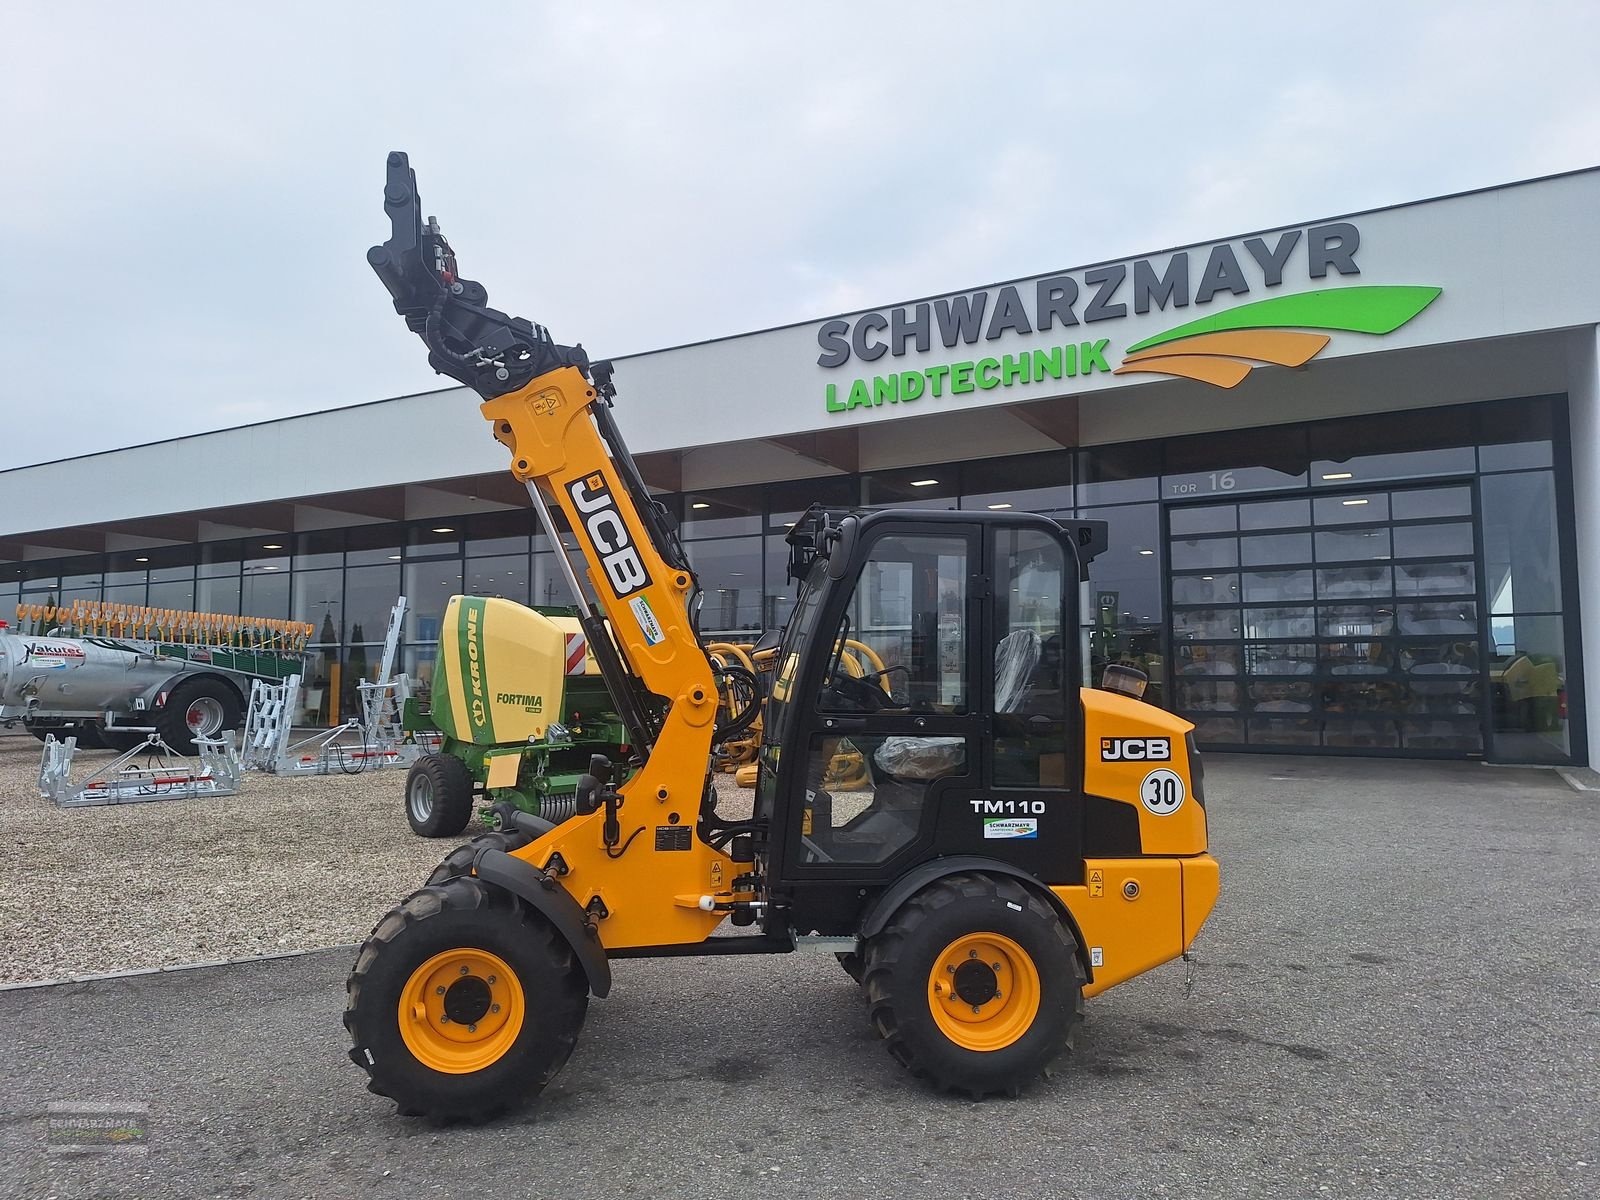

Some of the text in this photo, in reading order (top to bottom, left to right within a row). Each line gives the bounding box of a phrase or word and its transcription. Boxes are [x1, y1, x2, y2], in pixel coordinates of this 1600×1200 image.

[816, 222, 1361, 368] SCHWARZMAYR
[826, 338, 1110, 413] LANDTECHNIK
[1172, 471, 1235, 494] TOR 16
[571, 480, 646, 594] JCB
[467, 607, 482, 697] KRONE
[496, 693, 543, 707] FORTIMA
[1102, 739, 1170, 760] JCB
[1149, 778, 1176, 806] 30
[969, 800, 1046, 814] TM110
